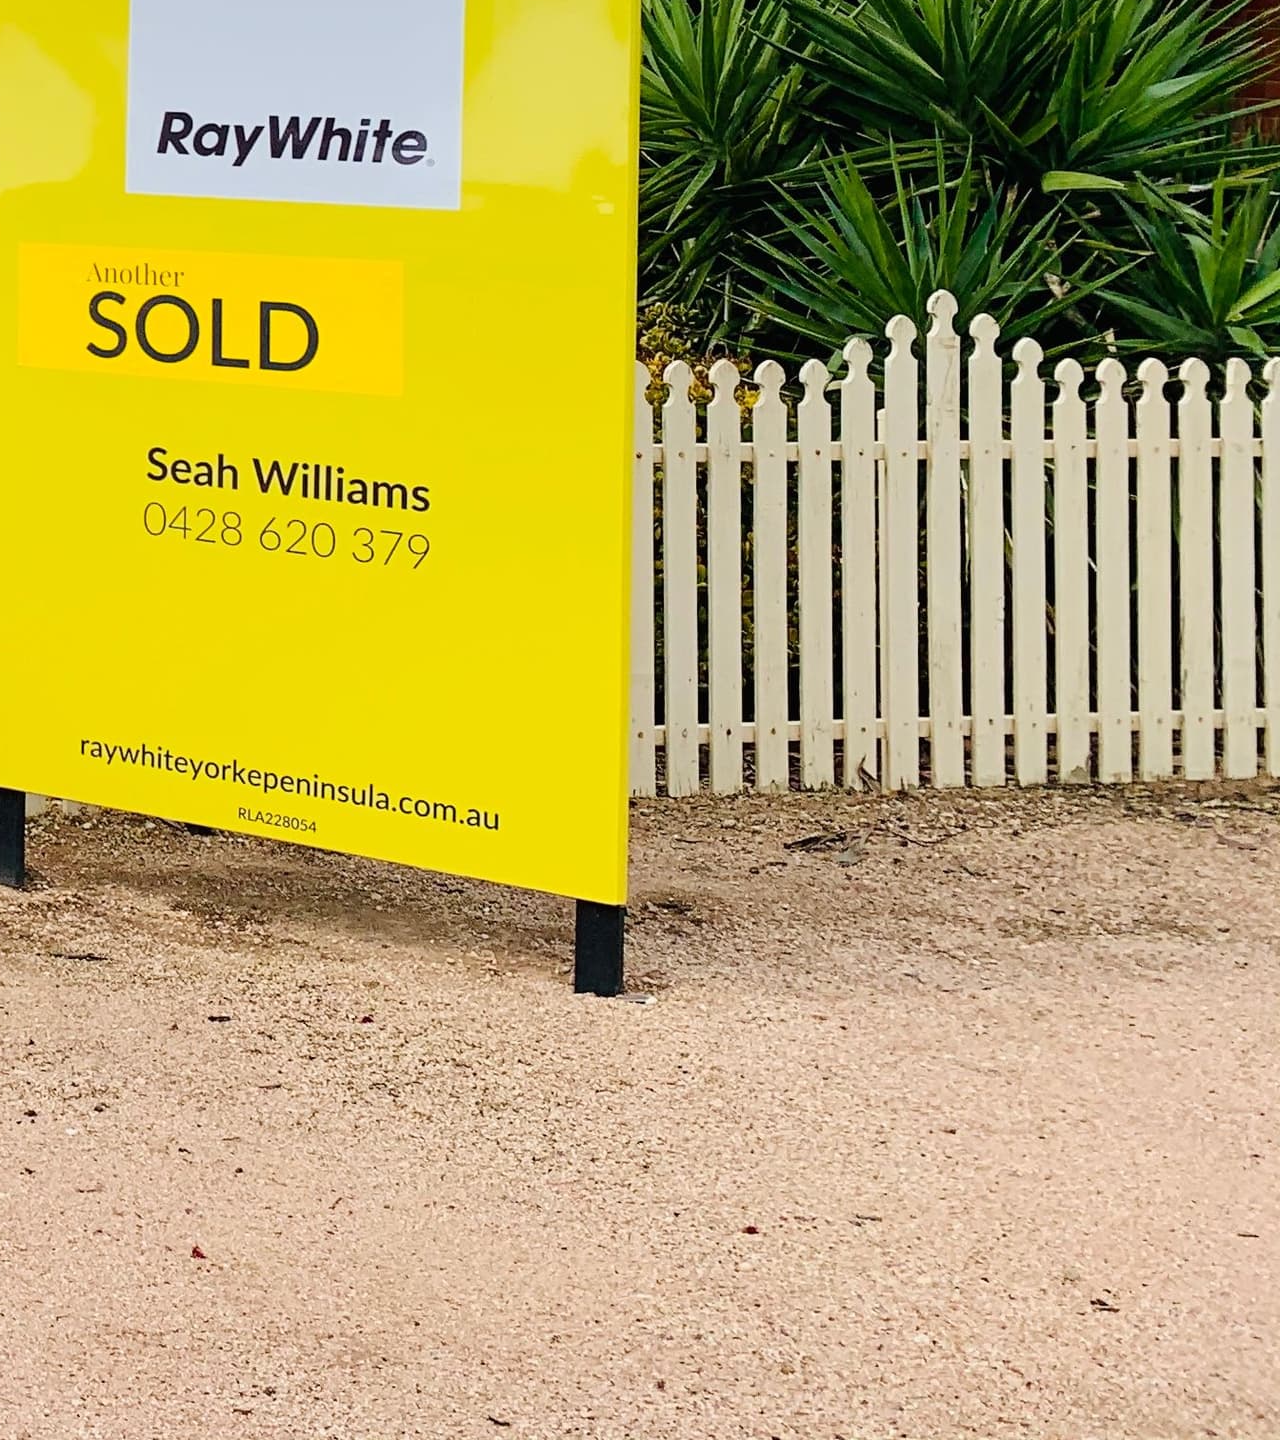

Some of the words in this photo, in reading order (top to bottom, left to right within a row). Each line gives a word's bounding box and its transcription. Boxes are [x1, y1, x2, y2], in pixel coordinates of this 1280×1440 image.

[86, 262, 185, 288] Another
[86, 290, 320, 372] SOLD
[146, 446, 239, 491] Seah
[252, 457, 431, 512] Williams
[143, 501, 243, 547] 0428
[259, 516, 336, 558] 620
[351, 527, 431, 570] 379
[80, 736, 500, 831] raywhiteyorkepeninsula.com.au
[237, 806, 317, 834] RLA228054
